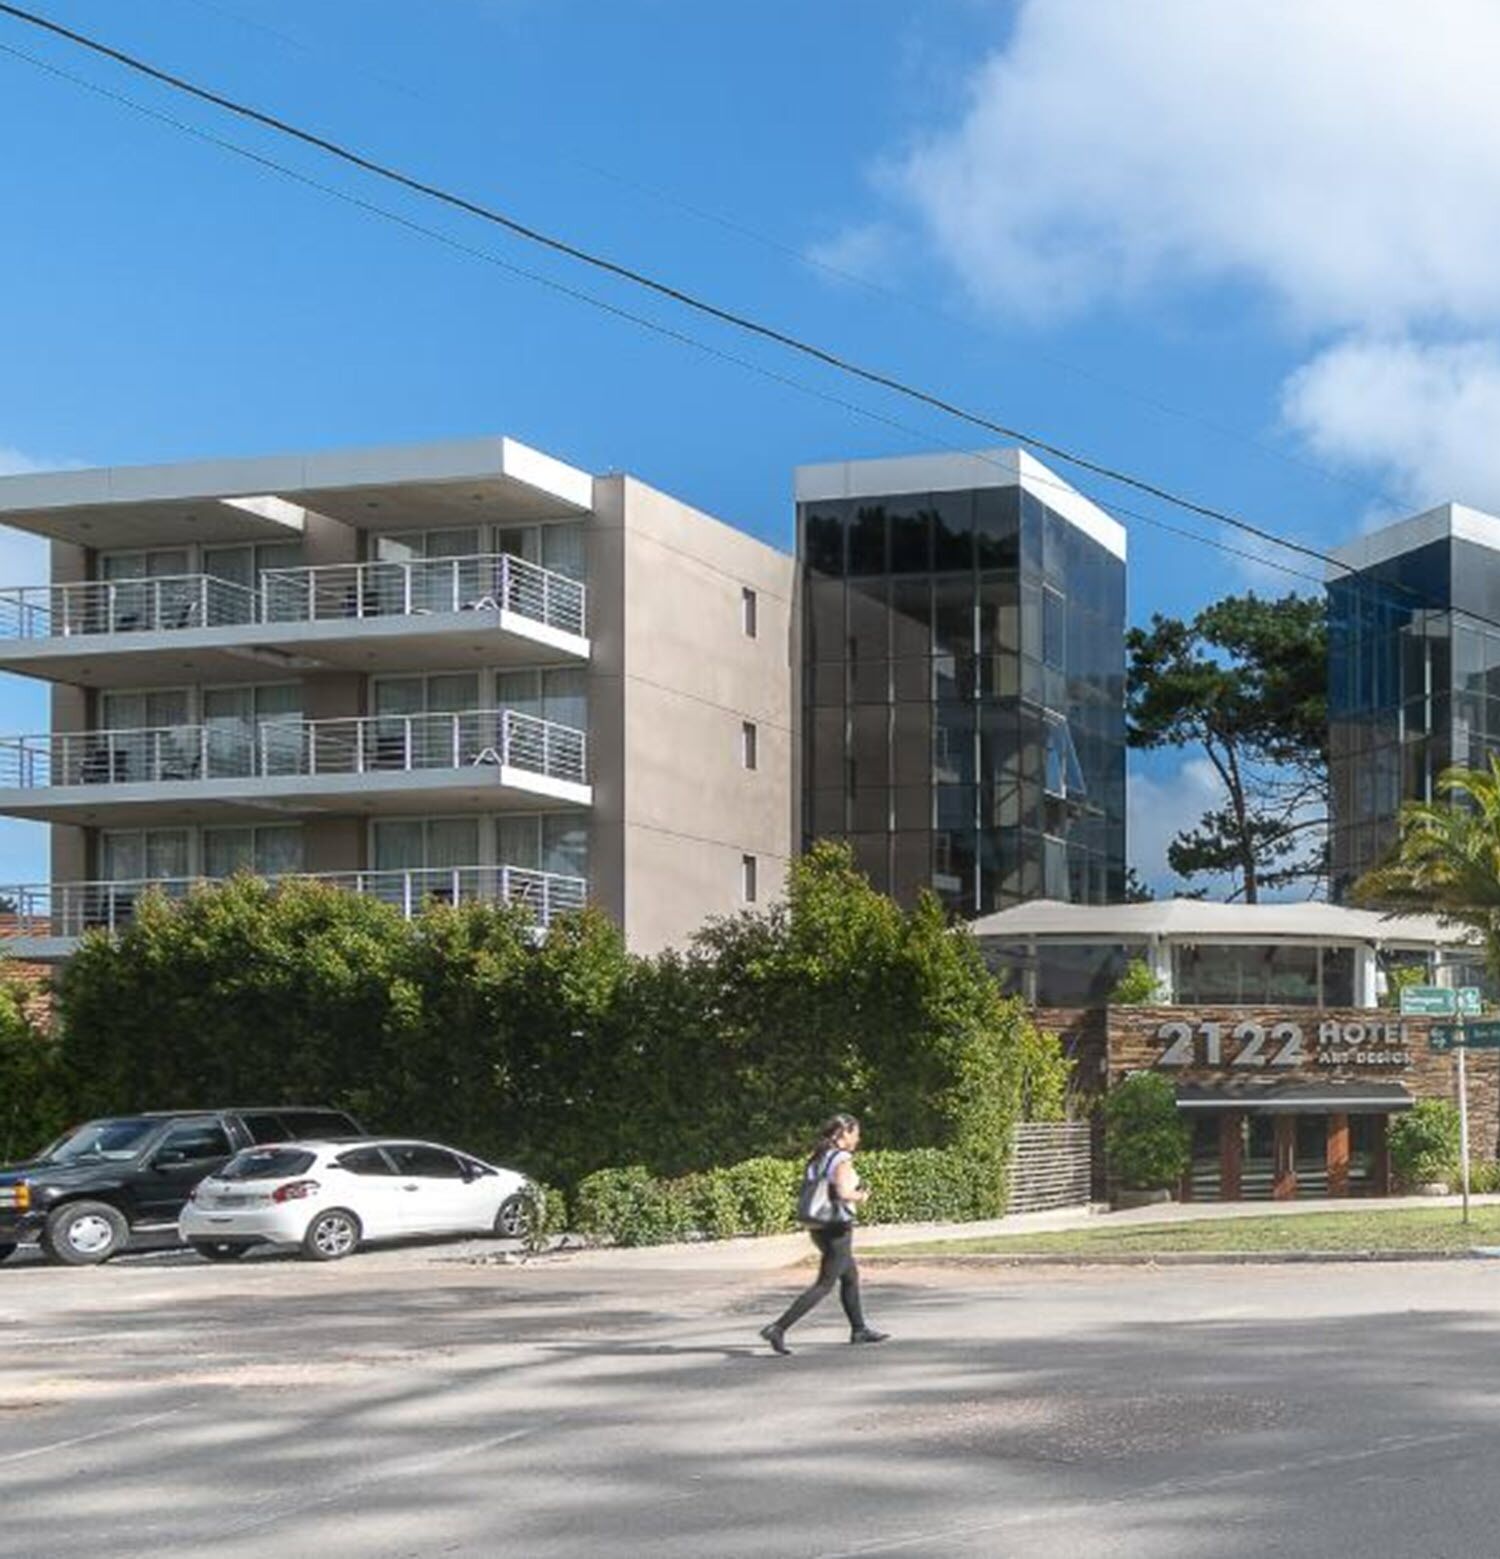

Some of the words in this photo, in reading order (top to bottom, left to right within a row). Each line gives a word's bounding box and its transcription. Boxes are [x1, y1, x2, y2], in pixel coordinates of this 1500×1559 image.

[1157, 1021, 1304, 1065] 2122
[1319, 1022, 1411, 1044] HOTEL
[1318, 1051, 1349, 1064] ART
